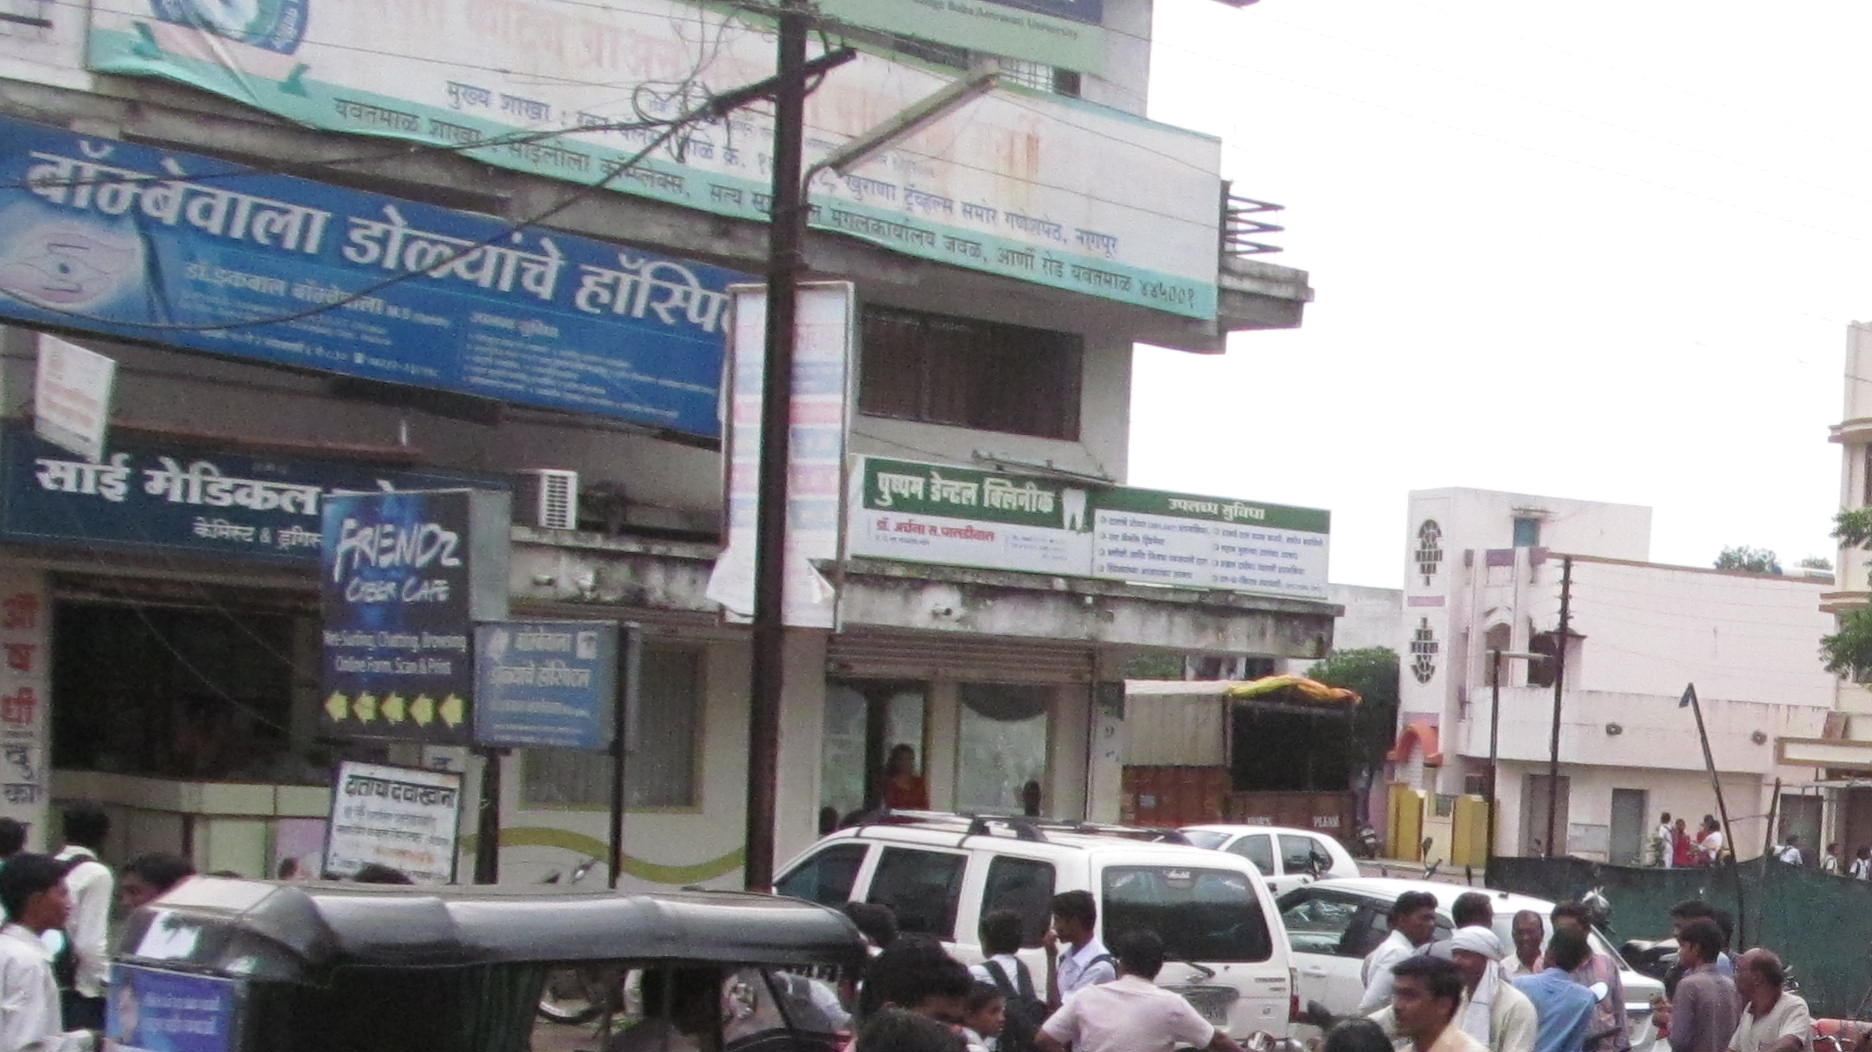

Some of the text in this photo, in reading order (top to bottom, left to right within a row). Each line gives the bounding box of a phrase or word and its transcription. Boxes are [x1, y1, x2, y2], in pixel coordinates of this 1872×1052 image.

[25, 139, 731, 333] बॉम्बेवाला डोळ्यांचे हॉस्पि
[34, 453, 322, 516] साई मेडिकल
[876, 471, 925, 507] पुष्पम
